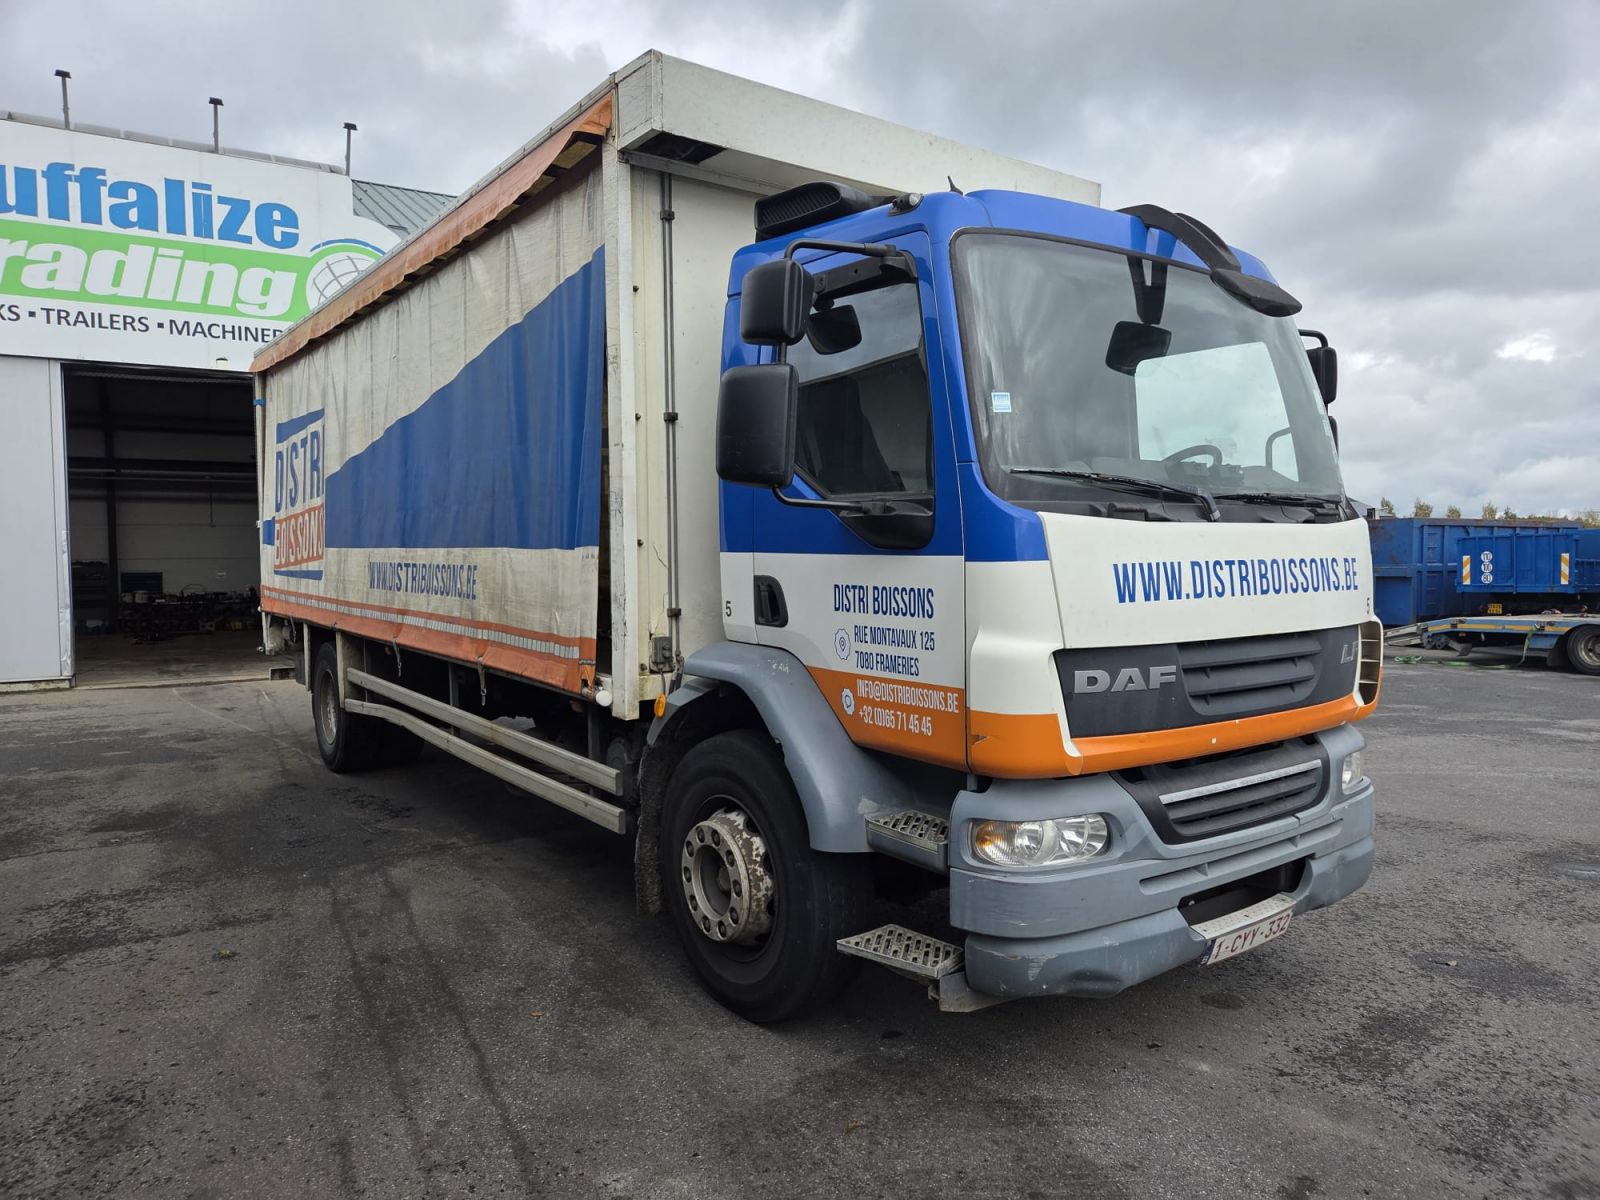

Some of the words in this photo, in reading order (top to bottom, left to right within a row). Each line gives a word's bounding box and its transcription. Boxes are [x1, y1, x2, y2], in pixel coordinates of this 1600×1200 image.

[0, 238, 297, 317] rading
[40, 307, 149, 333] TRAILERS
[275, 423, 325, 513] DISTRI
[275, 507, 325, 566] BOISSONS
[368, 561, 478, 600] WWW.DISTRIBOISSONS.BE
[1112, 557, 1359, 604] WWW.DISTRIBOISSONS.BE
[725, 600, 732, 617] 5
[833, 584, 869, 614] DISTRI
[872, 585, 934, 619] BOISSONS
[854, 625, 868, 644] RUE
[870, 626, 917, 649] MONTAVAUX
[920, 631, 935, 651] 125
[855, 651, 874, 671] 7080
[875, 653, 920, 677] FRAMERIES
[1073, 665, 1177, 694] DAF
[856, 679, 959, 713] INFO@DISTRIBOISSONS.BE
[859, 705, 873, 724] +32
[874, 707, 896, 729] (0)65
[897, 711, 907, 731] 71
[909, 713, 920, 734] 45
[921, 715, 932, 736] 45
